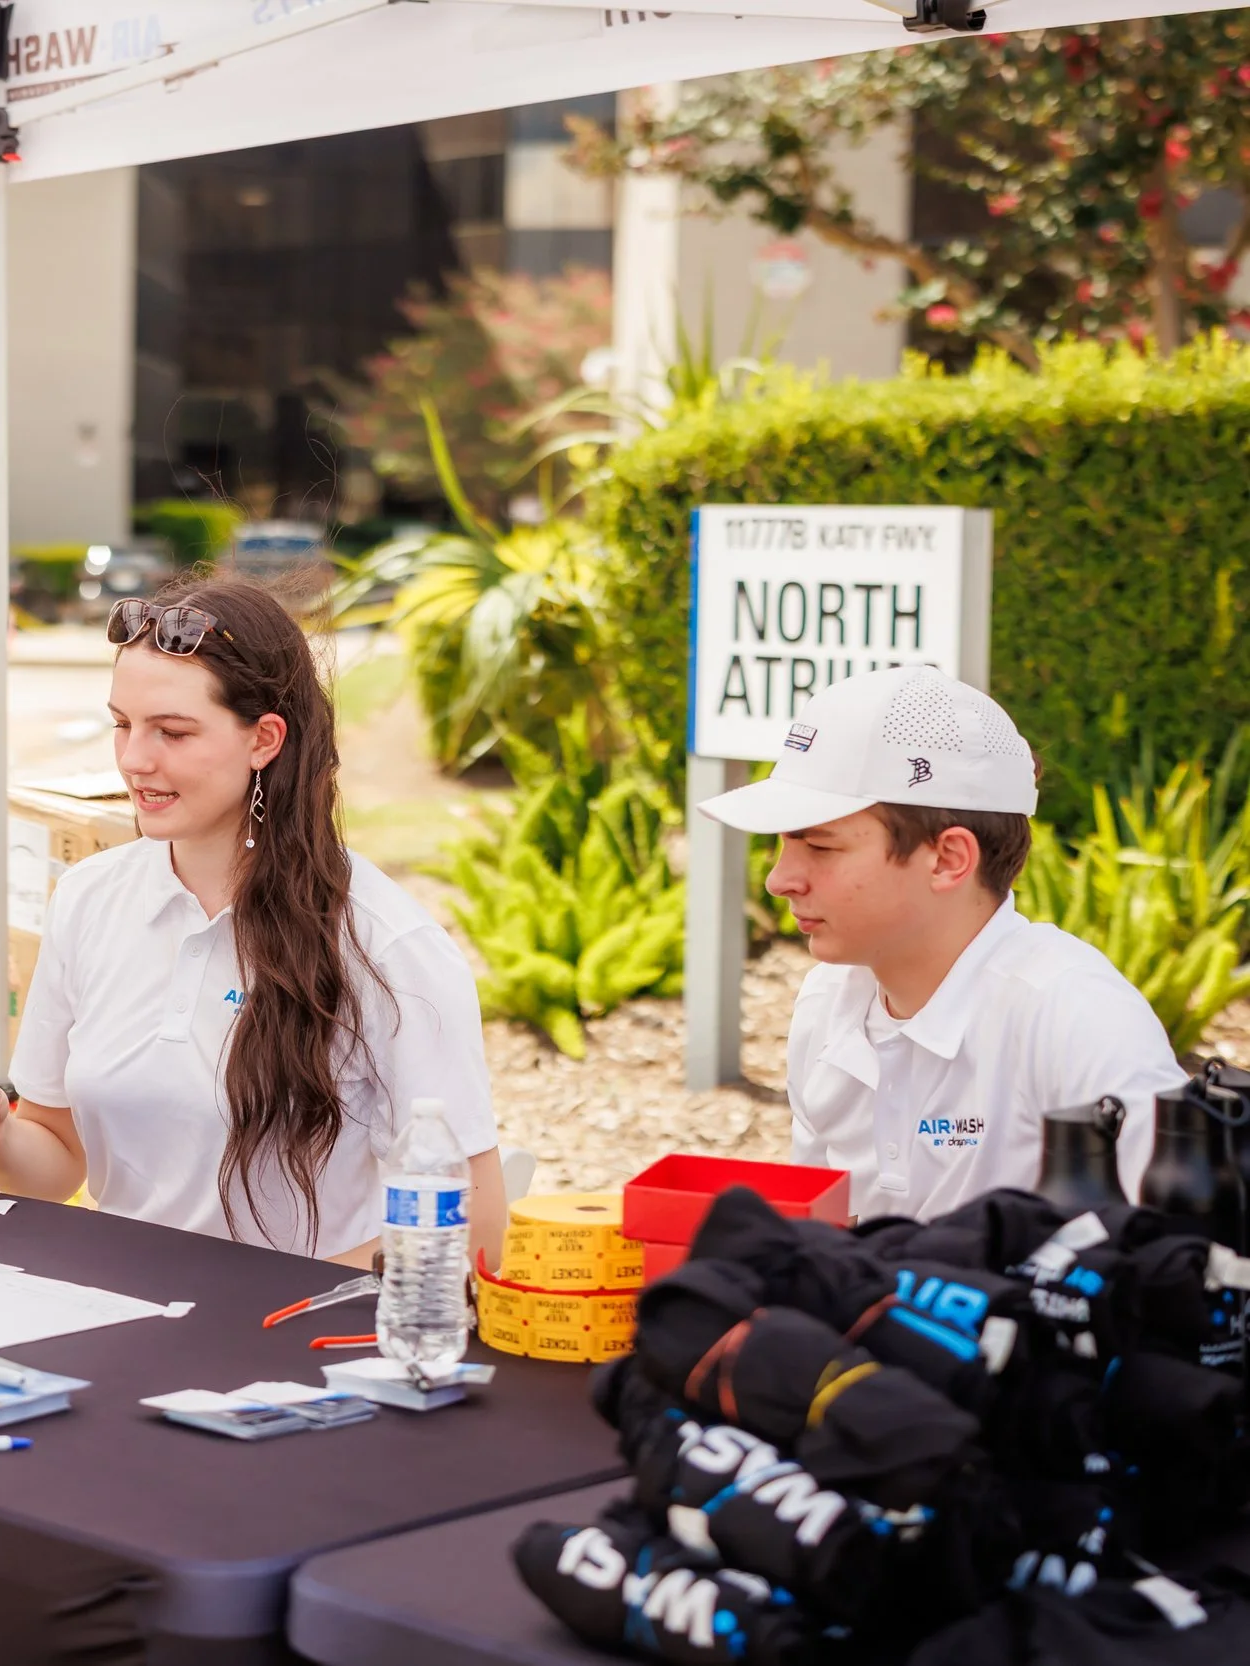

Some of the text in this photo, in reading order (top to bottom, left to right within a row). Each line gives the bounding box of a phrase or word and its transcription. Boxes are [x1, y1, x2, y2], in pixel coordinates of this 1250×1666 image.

[818, 524, 876, 551] KATY
[732, 580, 922, 649] NORTH
[718, 655, 940, 718] ATR
[552, 1268, 593, 1280] TICKET
[616, 1265, 643, 1279] CKET
[539, 1336, 580, 1351] TICKET
